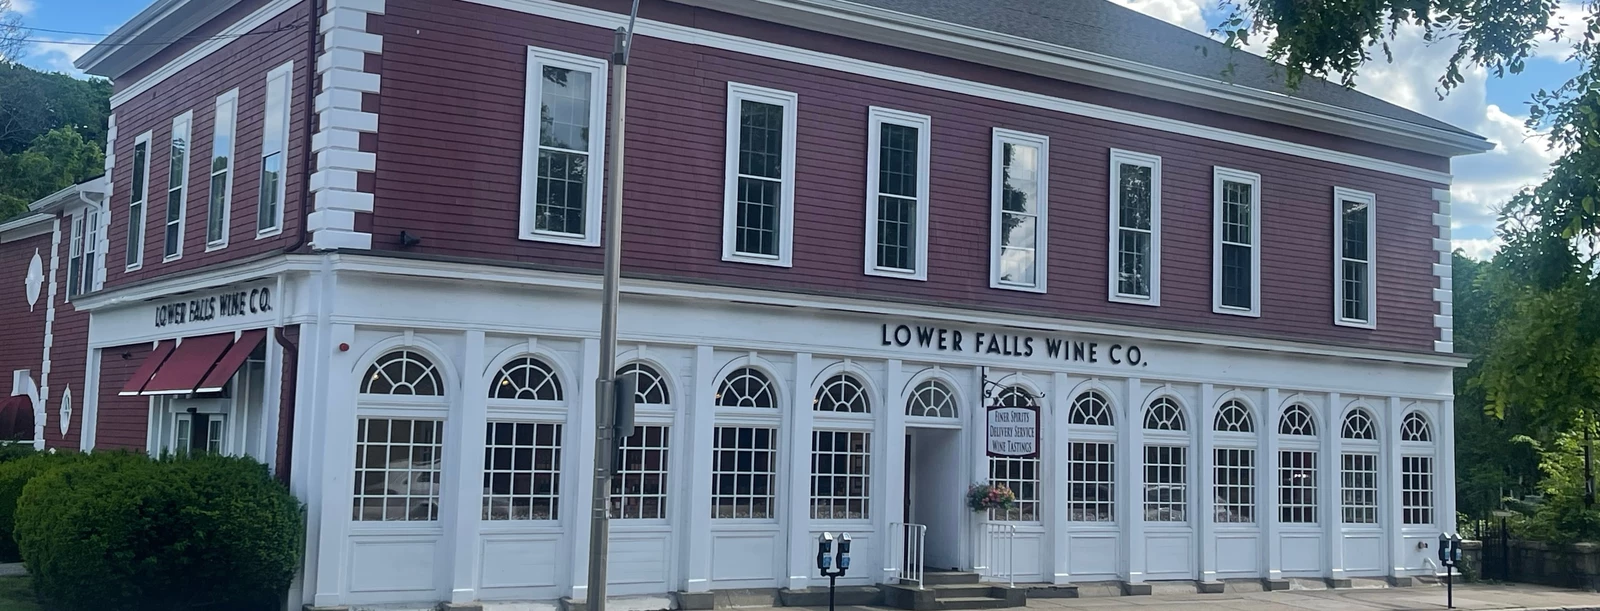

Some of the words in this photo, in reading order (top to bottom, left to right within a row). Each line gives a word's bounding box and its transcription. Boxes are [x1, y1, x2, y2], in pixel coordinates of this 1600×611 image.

[155, 302, 187, 328] LOWER
[189, 296, 216, 322] FALLS
[220, 291, 247, 317] WINE
[249, 287, 273, 314] CO.
[881, 323, 963, 351] LOWER
[975, 332, 1033, 357] FALLS
[1046, 338, 1098, 364] WINE
[1109, 344, 1148, 367] CO.
